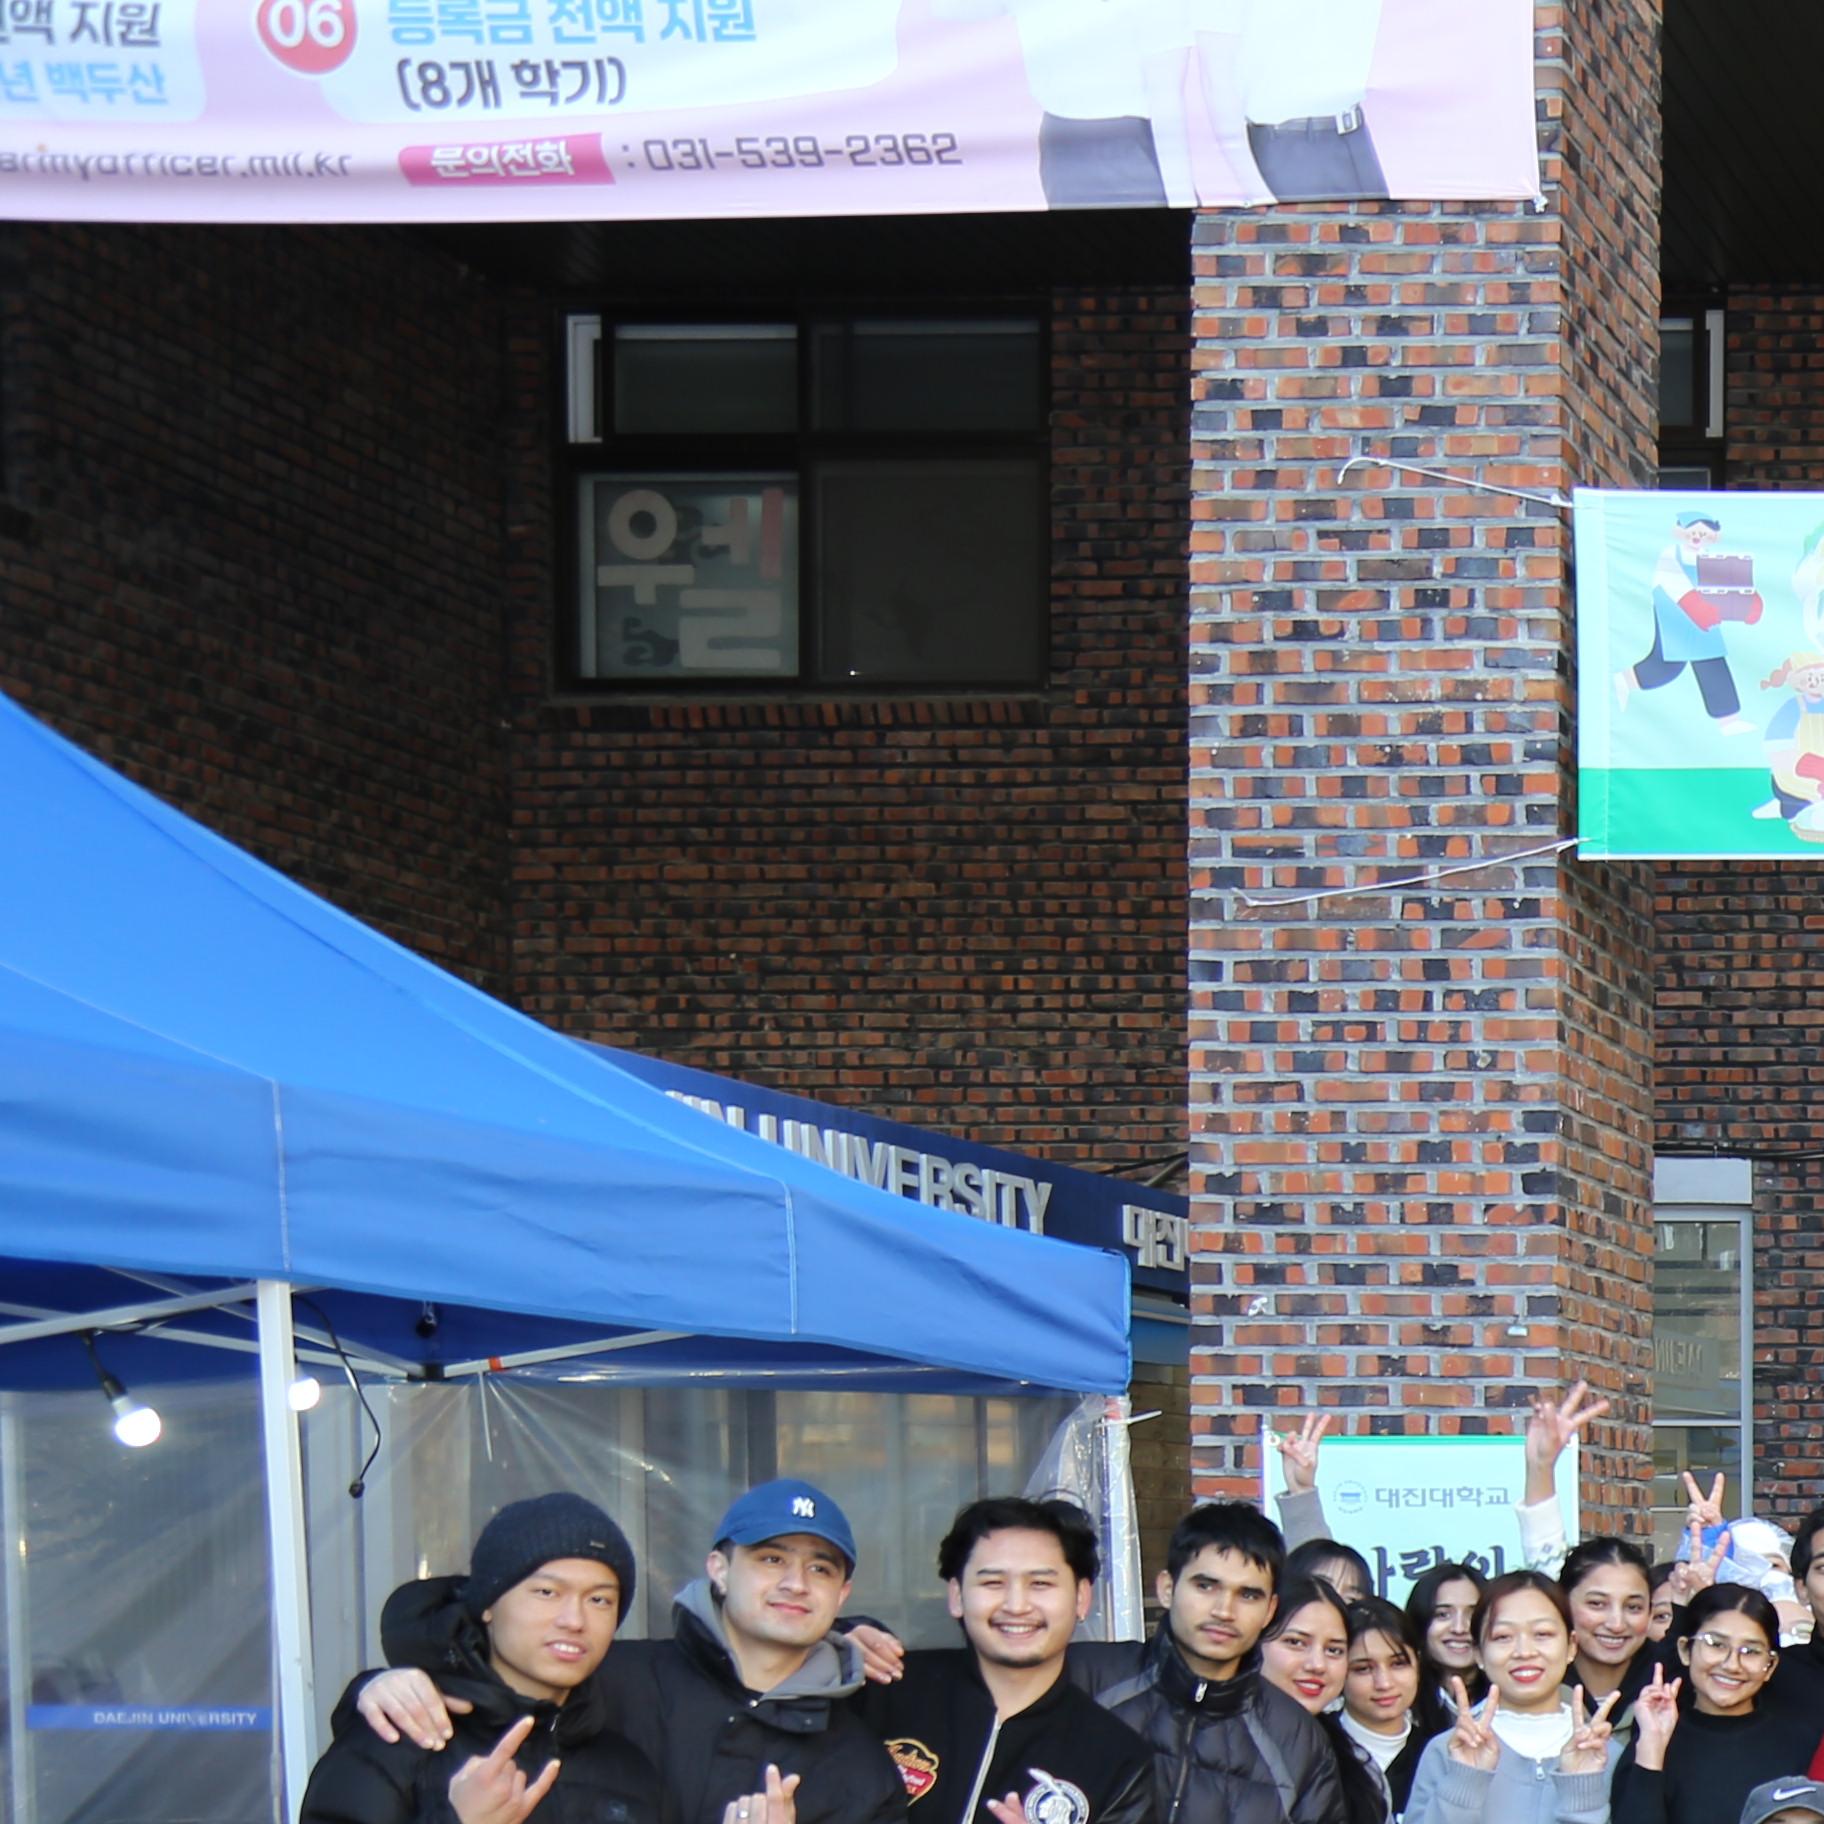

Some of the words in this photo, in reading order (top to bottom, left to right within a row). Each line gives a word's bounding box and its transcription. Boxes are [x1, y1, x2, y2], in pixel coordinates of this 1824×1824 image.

[0, 0, 54, 45] 액
[267, 0, 345, 48] 06
[397, 58, 502, 110] (8개
[509, 56, 628, 106] 학기)
[430, 140, 576, 178] 문의전화
[1375, 1486, 1511, 1508] 대진대학교
